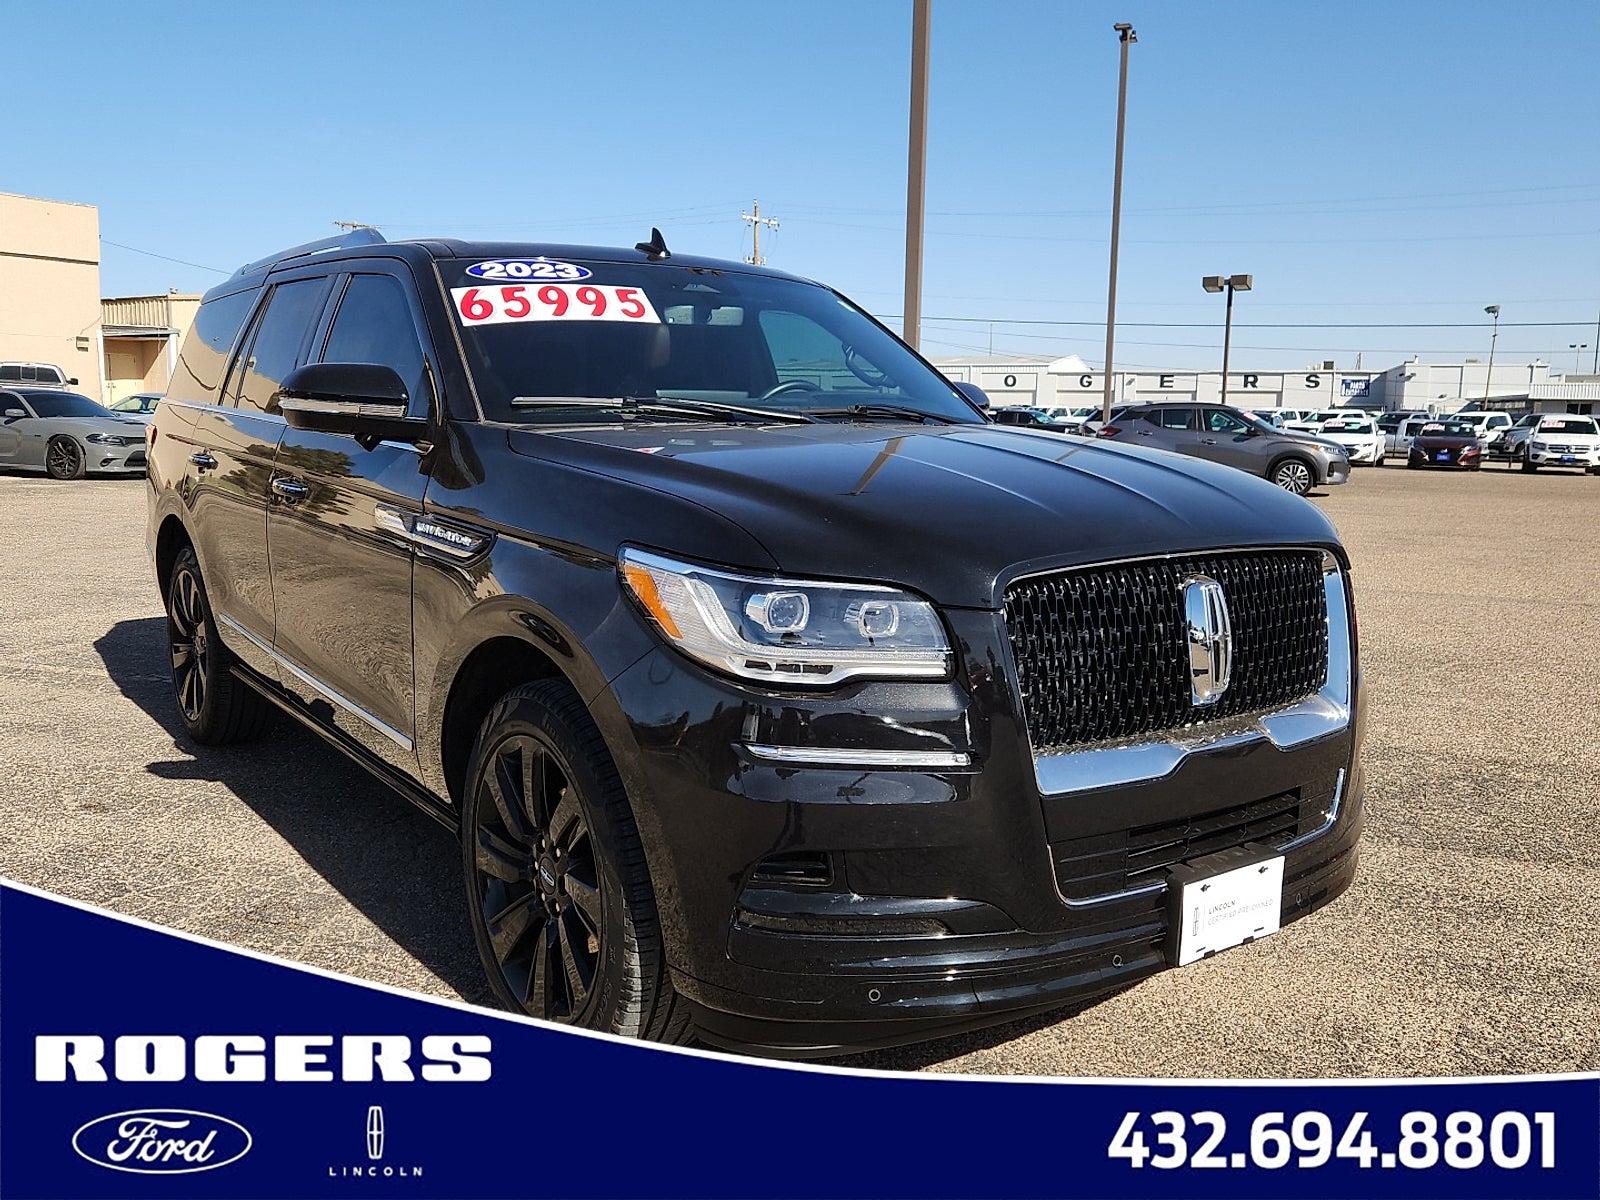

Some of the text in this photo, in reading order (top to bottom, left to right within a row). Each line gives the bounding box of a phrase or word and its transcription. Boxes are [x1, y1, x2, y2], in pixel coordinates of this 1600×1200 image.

[481, 261, 580, 278] 2023
[460, 285, 646, 320] 65995
[1208, 900, 1236, 915] LINCOLN
